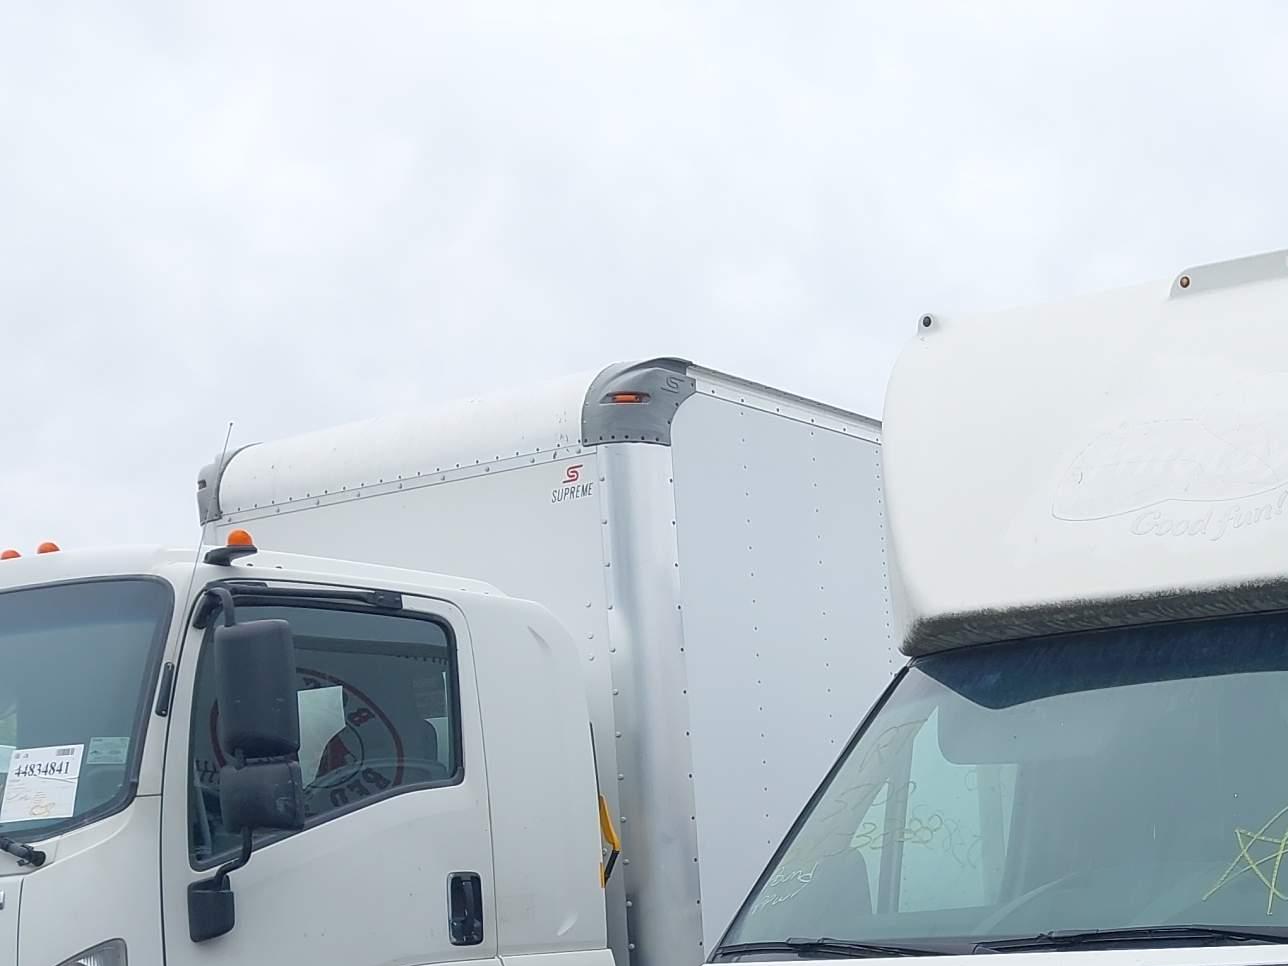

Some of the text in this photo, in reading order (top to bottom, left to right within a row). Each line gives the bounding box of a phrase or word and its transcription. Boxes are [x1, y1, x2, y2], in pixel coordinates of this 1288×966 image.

[551, 482, 594, 504] SUPREME
[1129, 489, 1288, 542] Good fun!
[13, 760, 71, 778] 44834841
